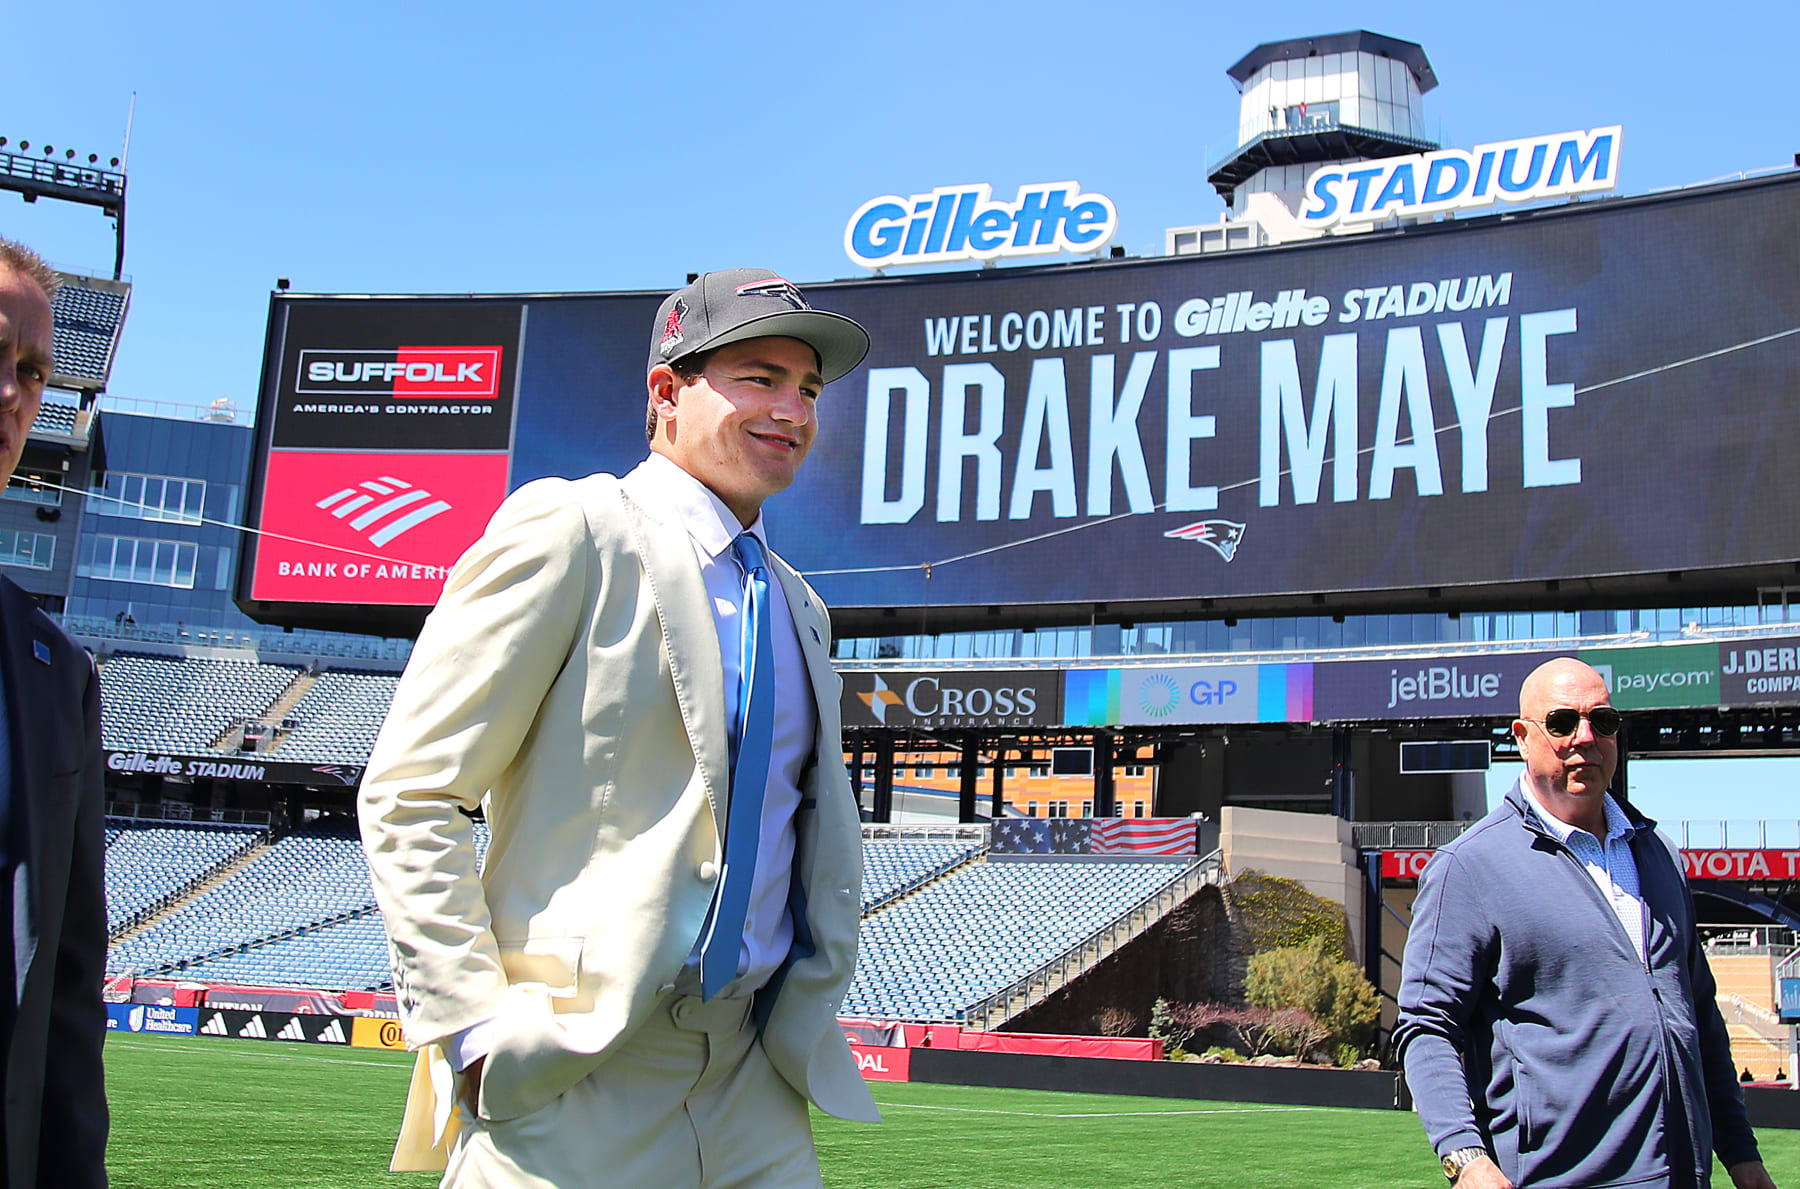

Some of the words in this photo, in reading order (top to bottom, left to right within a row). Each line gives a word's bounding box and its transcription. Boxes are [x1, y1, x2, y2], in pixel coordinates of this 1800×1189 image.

[851, 187, 1109, 259] Gillette
[1307, 135, 1612, 220] STADIUM
[925, 305, 1105, 357] WELCOME
[1117, 300, 1162, 343] TO
[1174, 287, 1331, 338] Gillette
[1339, 271, 1513, 325] STADIUM
[308, 362, 483, 382] SUFFOLK
[293, 404, 380, 414] AMERICA'S
[385, 405, 492, 415] CONTRACTOR
[860, 344, 1221, 525] DRAKE
[1259, 307, 1582, 508] MAYE
[278, 561, 337, 577] BANK
[343, 562, 371, 579] OF
[1387, 666, 1500, 709] jetBlue
[1617, 670, 1710, 693] paycom
[912, 717, 1034, 726] INSURANCE
[107, 752, 183, 775] Gillette
[185, 761, 266, 781] STADIUM
[145, 1007, 177, 1020] United
[145, 1019, 192, 1033] Healthcare
